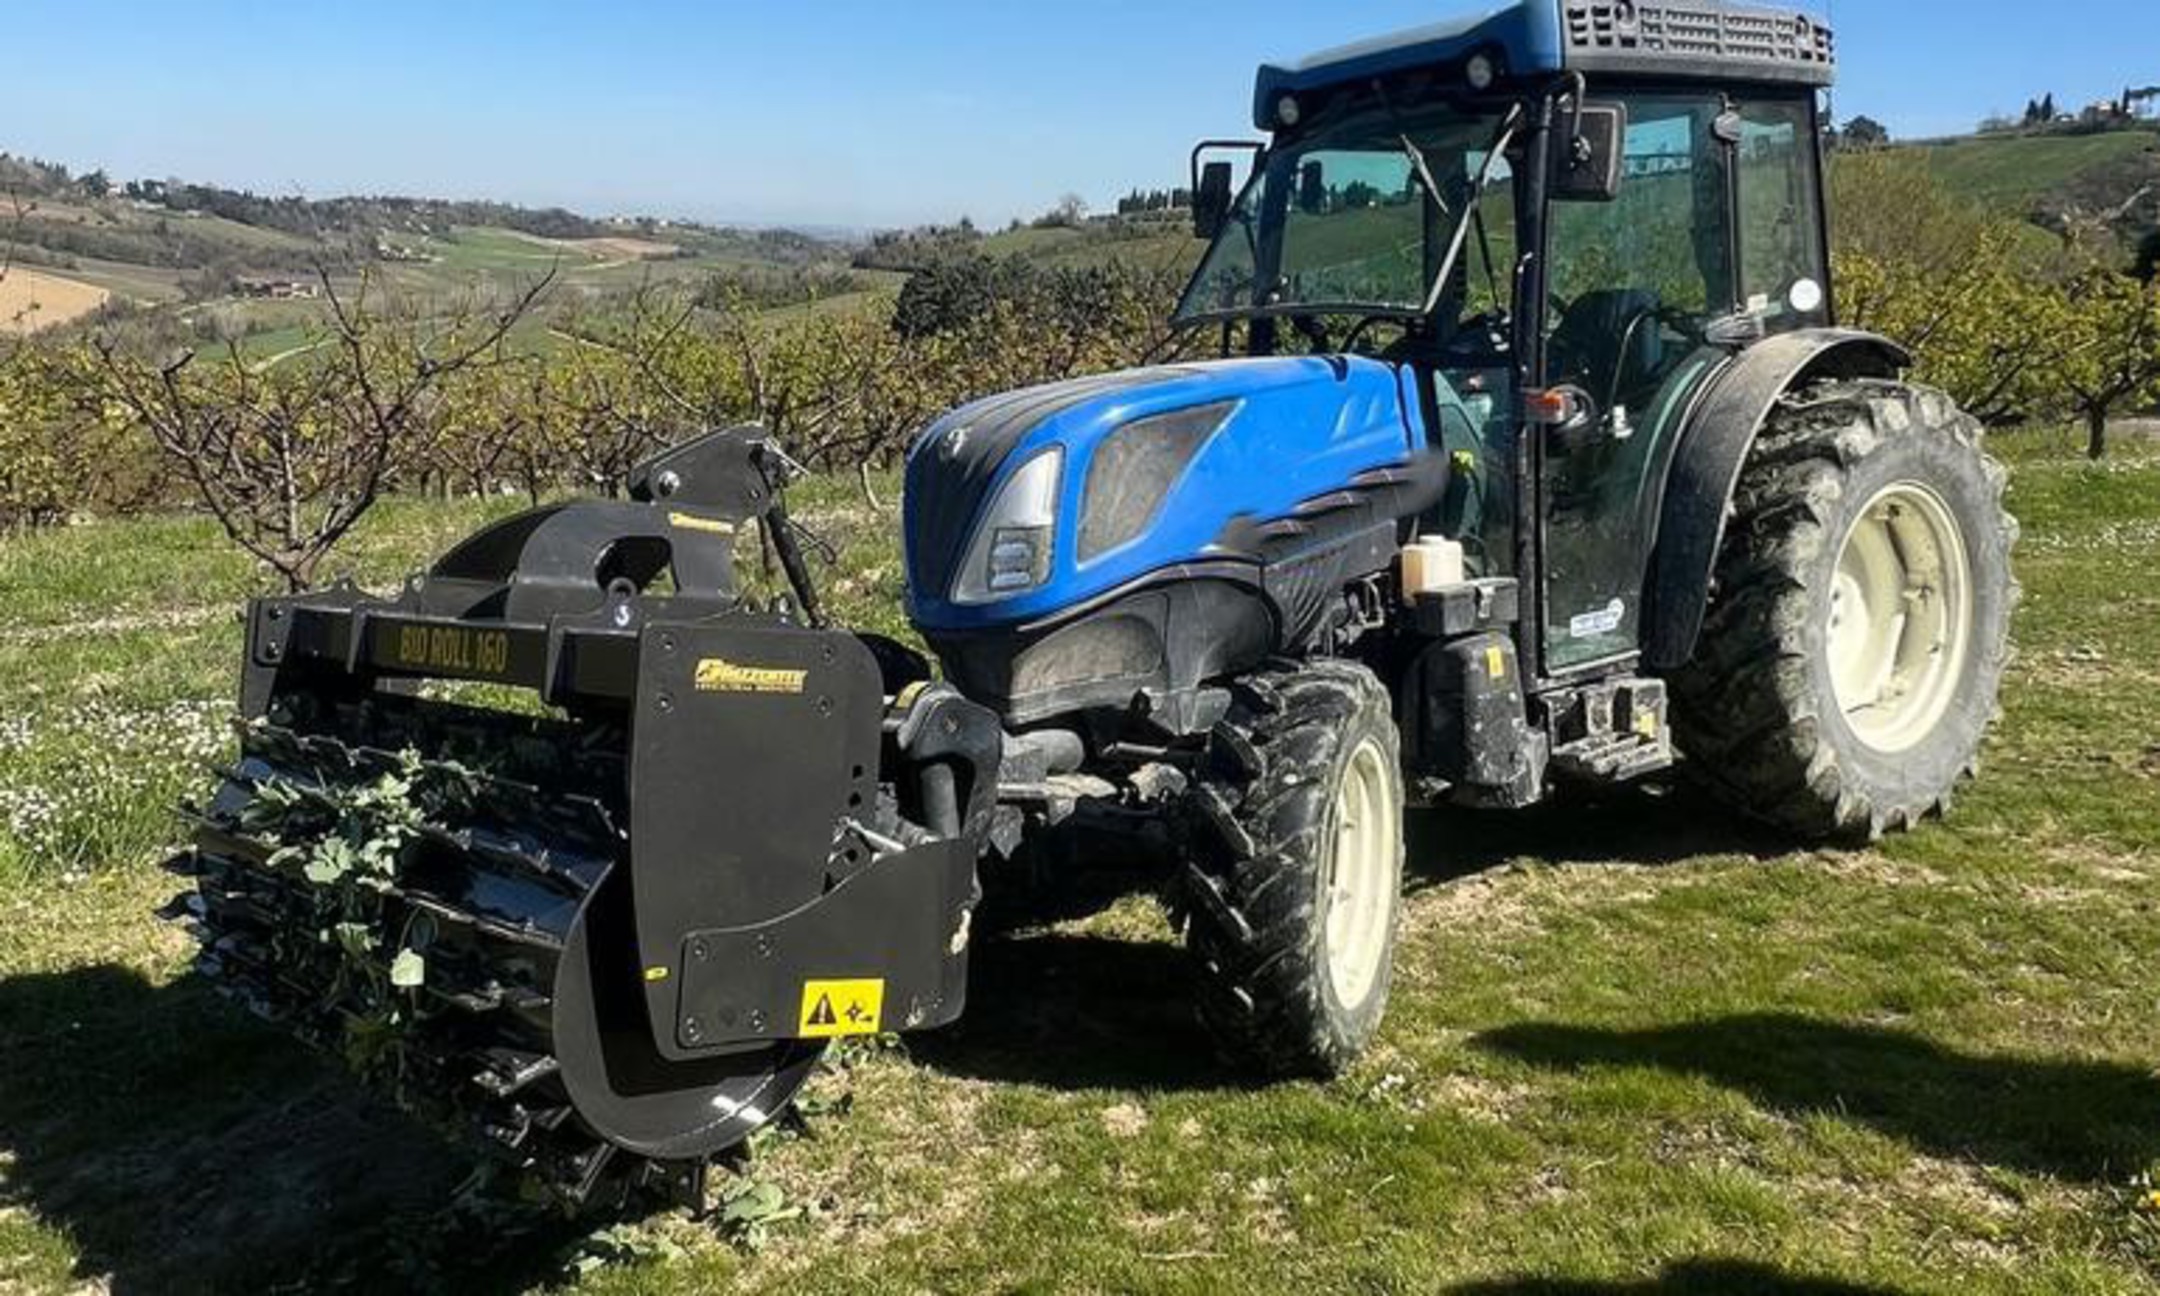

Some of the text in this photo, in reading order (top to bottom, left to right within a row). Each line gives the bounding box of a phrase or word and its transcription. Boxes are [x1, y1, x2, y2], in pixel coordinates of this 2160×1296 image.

[400, 625, 507, 673] BIO ROLL 160
